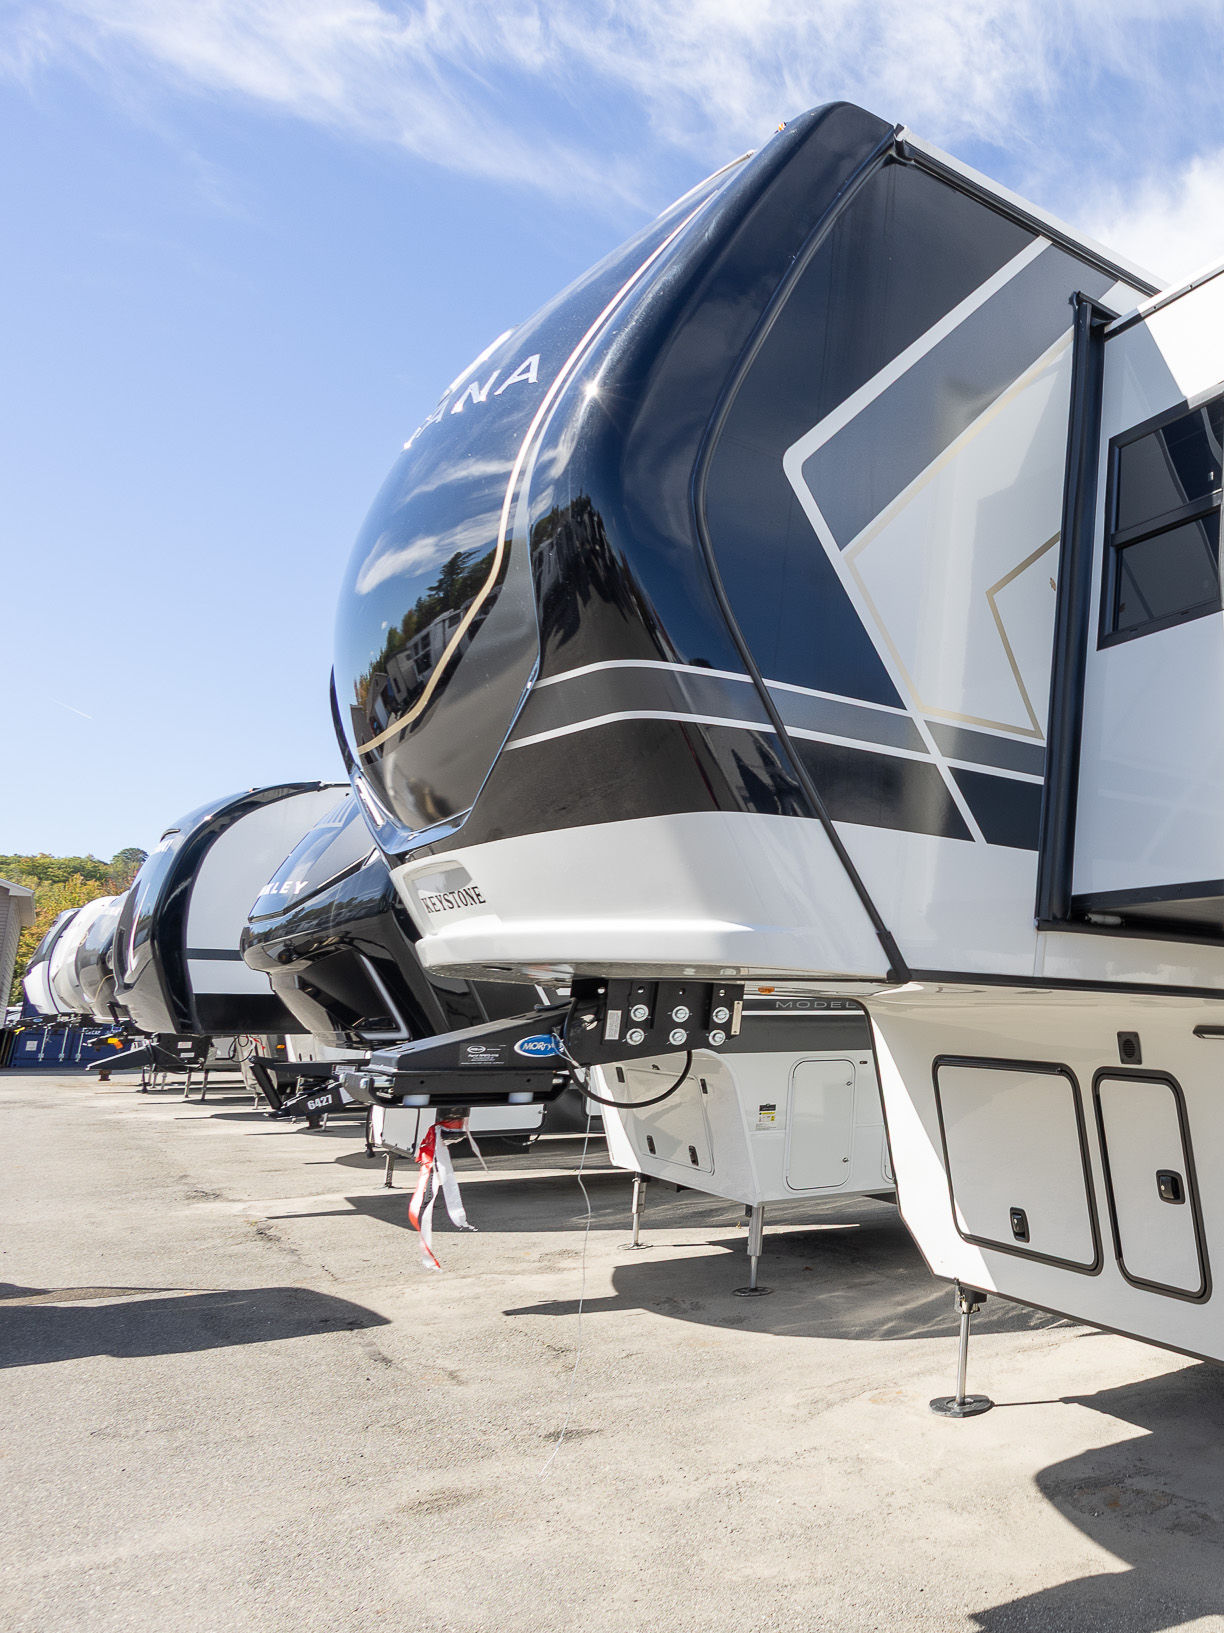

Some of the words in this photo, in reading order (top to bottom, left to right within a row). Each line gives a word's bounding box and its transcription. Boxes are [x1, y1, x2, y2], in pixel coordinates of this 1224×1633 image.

[420, 886, 486, 913] KEYSTONE
[775, 1001, 857, 1009] MODEL
[307, 1095, 332, 1110] 6427
